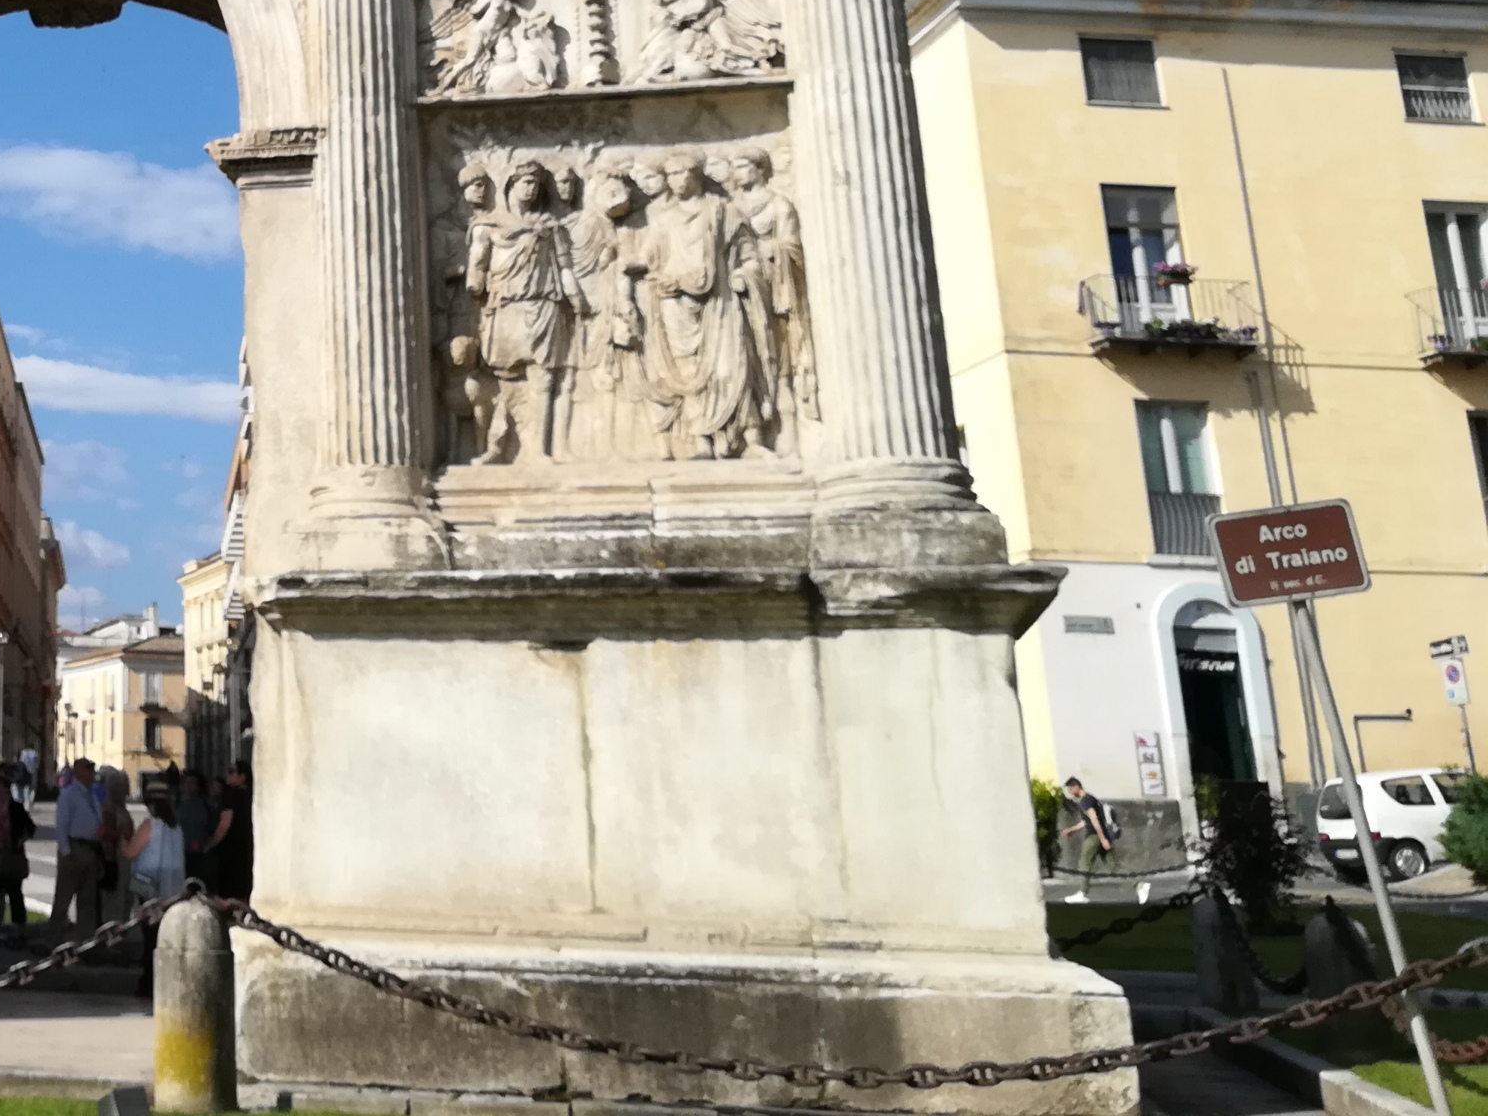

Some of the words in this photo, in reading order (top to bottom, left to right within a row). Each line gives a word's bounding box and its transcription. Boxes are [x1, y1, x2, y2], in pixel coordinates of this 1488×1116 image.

[1259, 523, 1308, 544] Arco
[1235, 554, 1256, 575] di
[1265, 546, 1348, 571] Traiano
